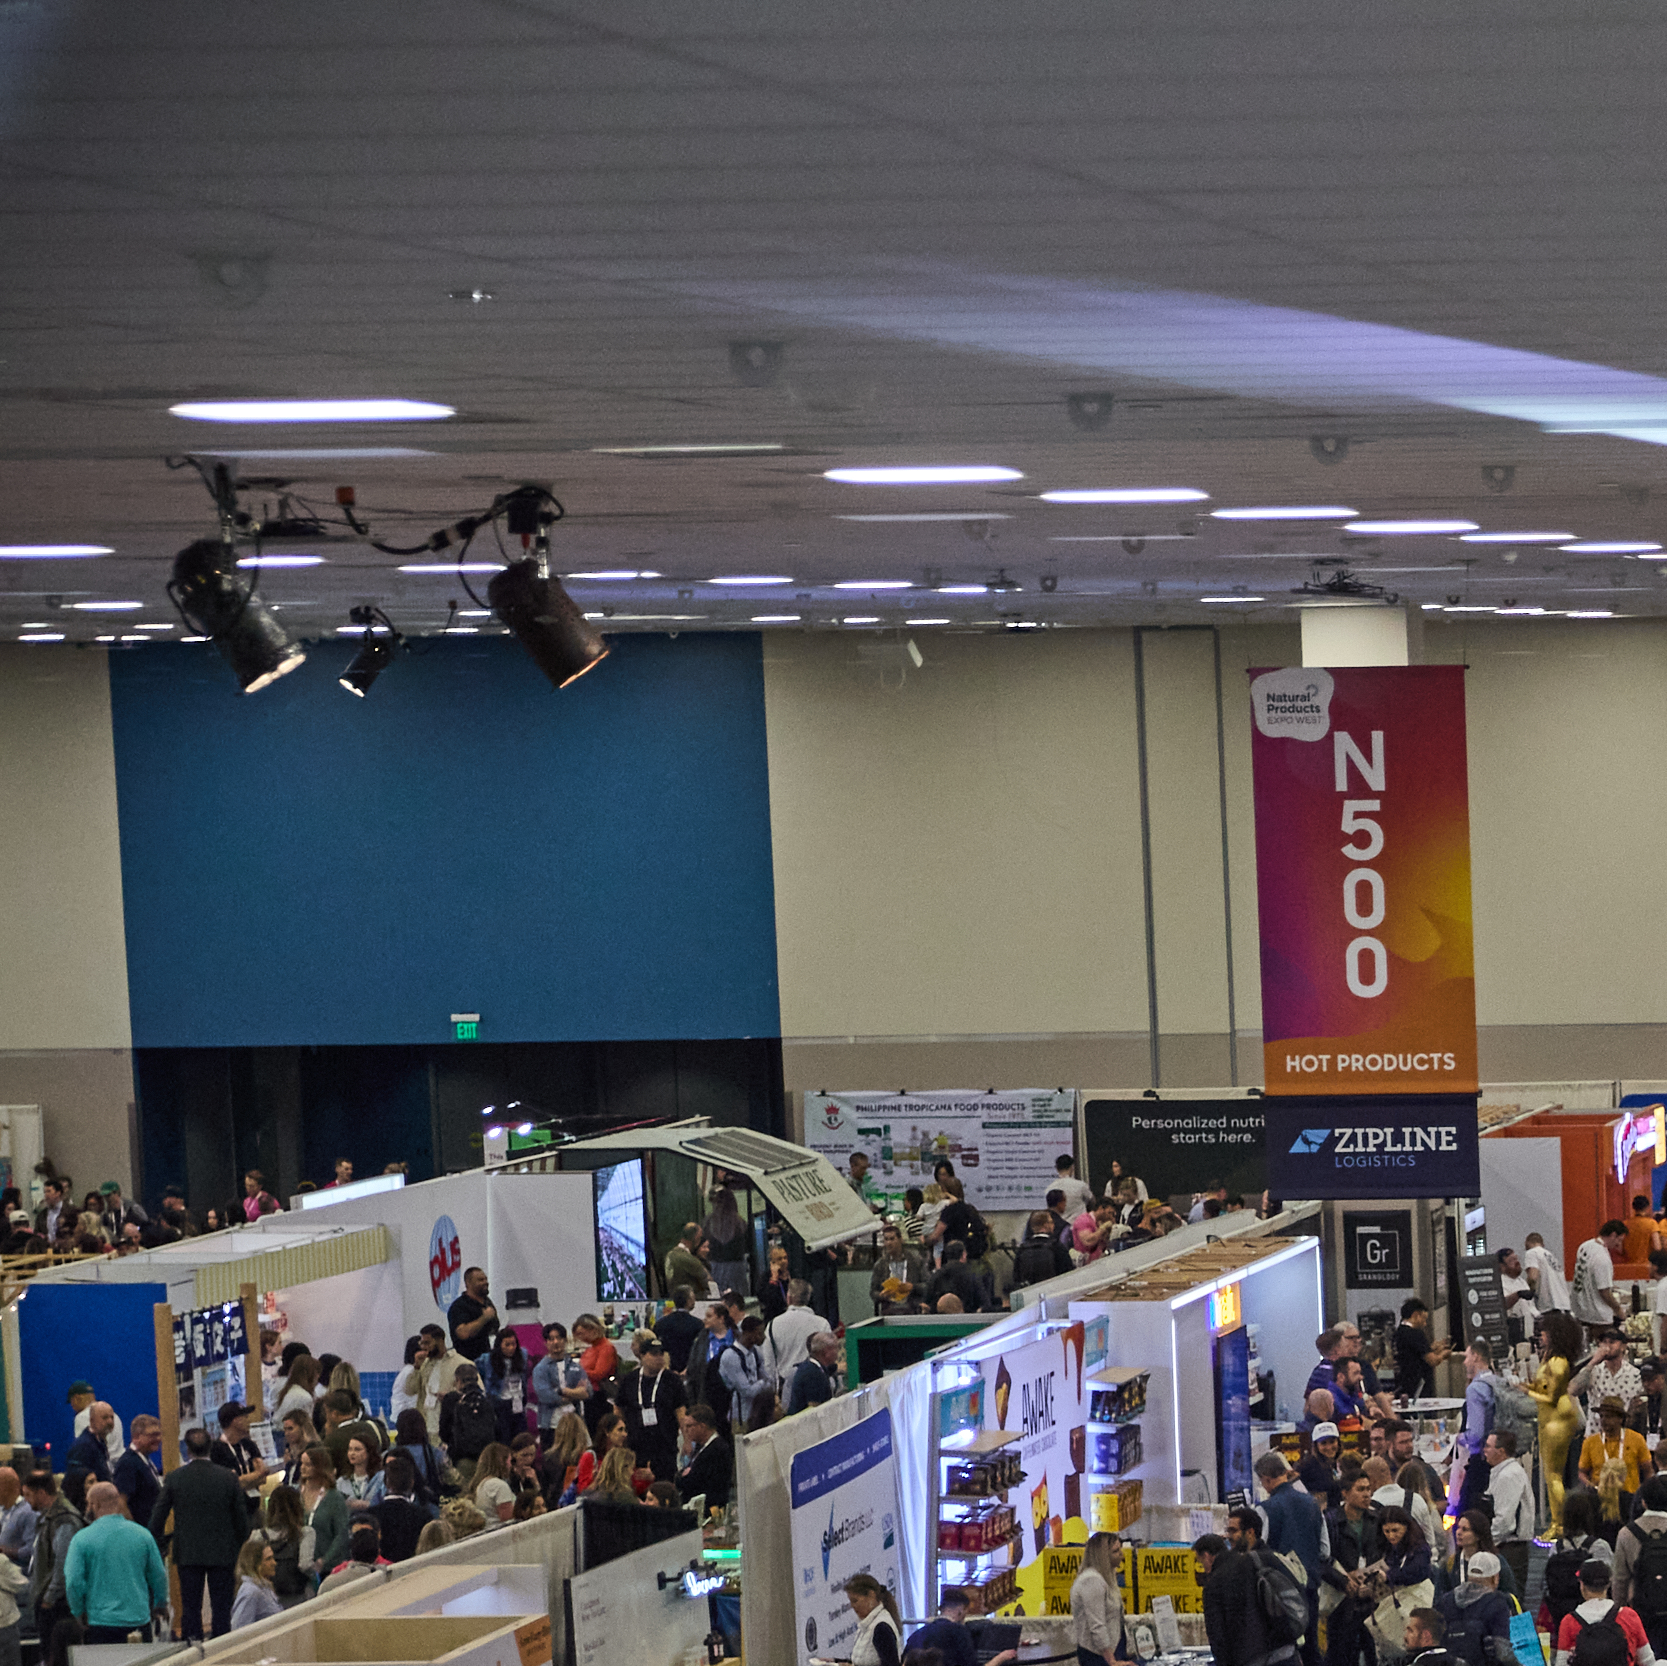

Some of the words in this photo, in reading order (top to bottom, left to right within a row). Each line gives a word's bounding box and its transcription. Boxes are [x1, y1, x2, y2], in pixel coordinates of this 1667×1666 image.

[1267, 692, 1310, 703] Natural
[1267, 703, 1321, 715] Products
[1267, 716, 1292, 724] EXPO
[1294, 716, 1323, 724] WEST
[457, 1022, 477, 1040] EXIT
[1286, 1055, 1331, 1073] HOT
[1337, 1053, 1455, 1072] PRODUCTS
[855, 1103, 902, 1113] PHILIPPINE
[904, 1102, 954, 1112] TROPICANA
[955, 1102, 980, 1111] FOOD
[981, 1101, 1027, 1111] PRODUCTS
[1131, 1114, 1221, 1130] Personalized
[1227, 1114, 1265, 1129] nutri
[1171, 1131, 1213, 1145] starts
[1216, 1130, 1256, 1144] here.
[1334, 1127, 1457, 1152] ZIPLINE
[1335, 1154, 1416, 1168] LOGISTICS
[771, 1167, 833, 1205] PASTURE
[1366, 1239, 1389, 1264] Gr
[429, 1235, 461, 1290] plus
[1021, 1371, 1056, 1437] AWAKE
[1143, 1554, 1189, 1576] AWAKE
